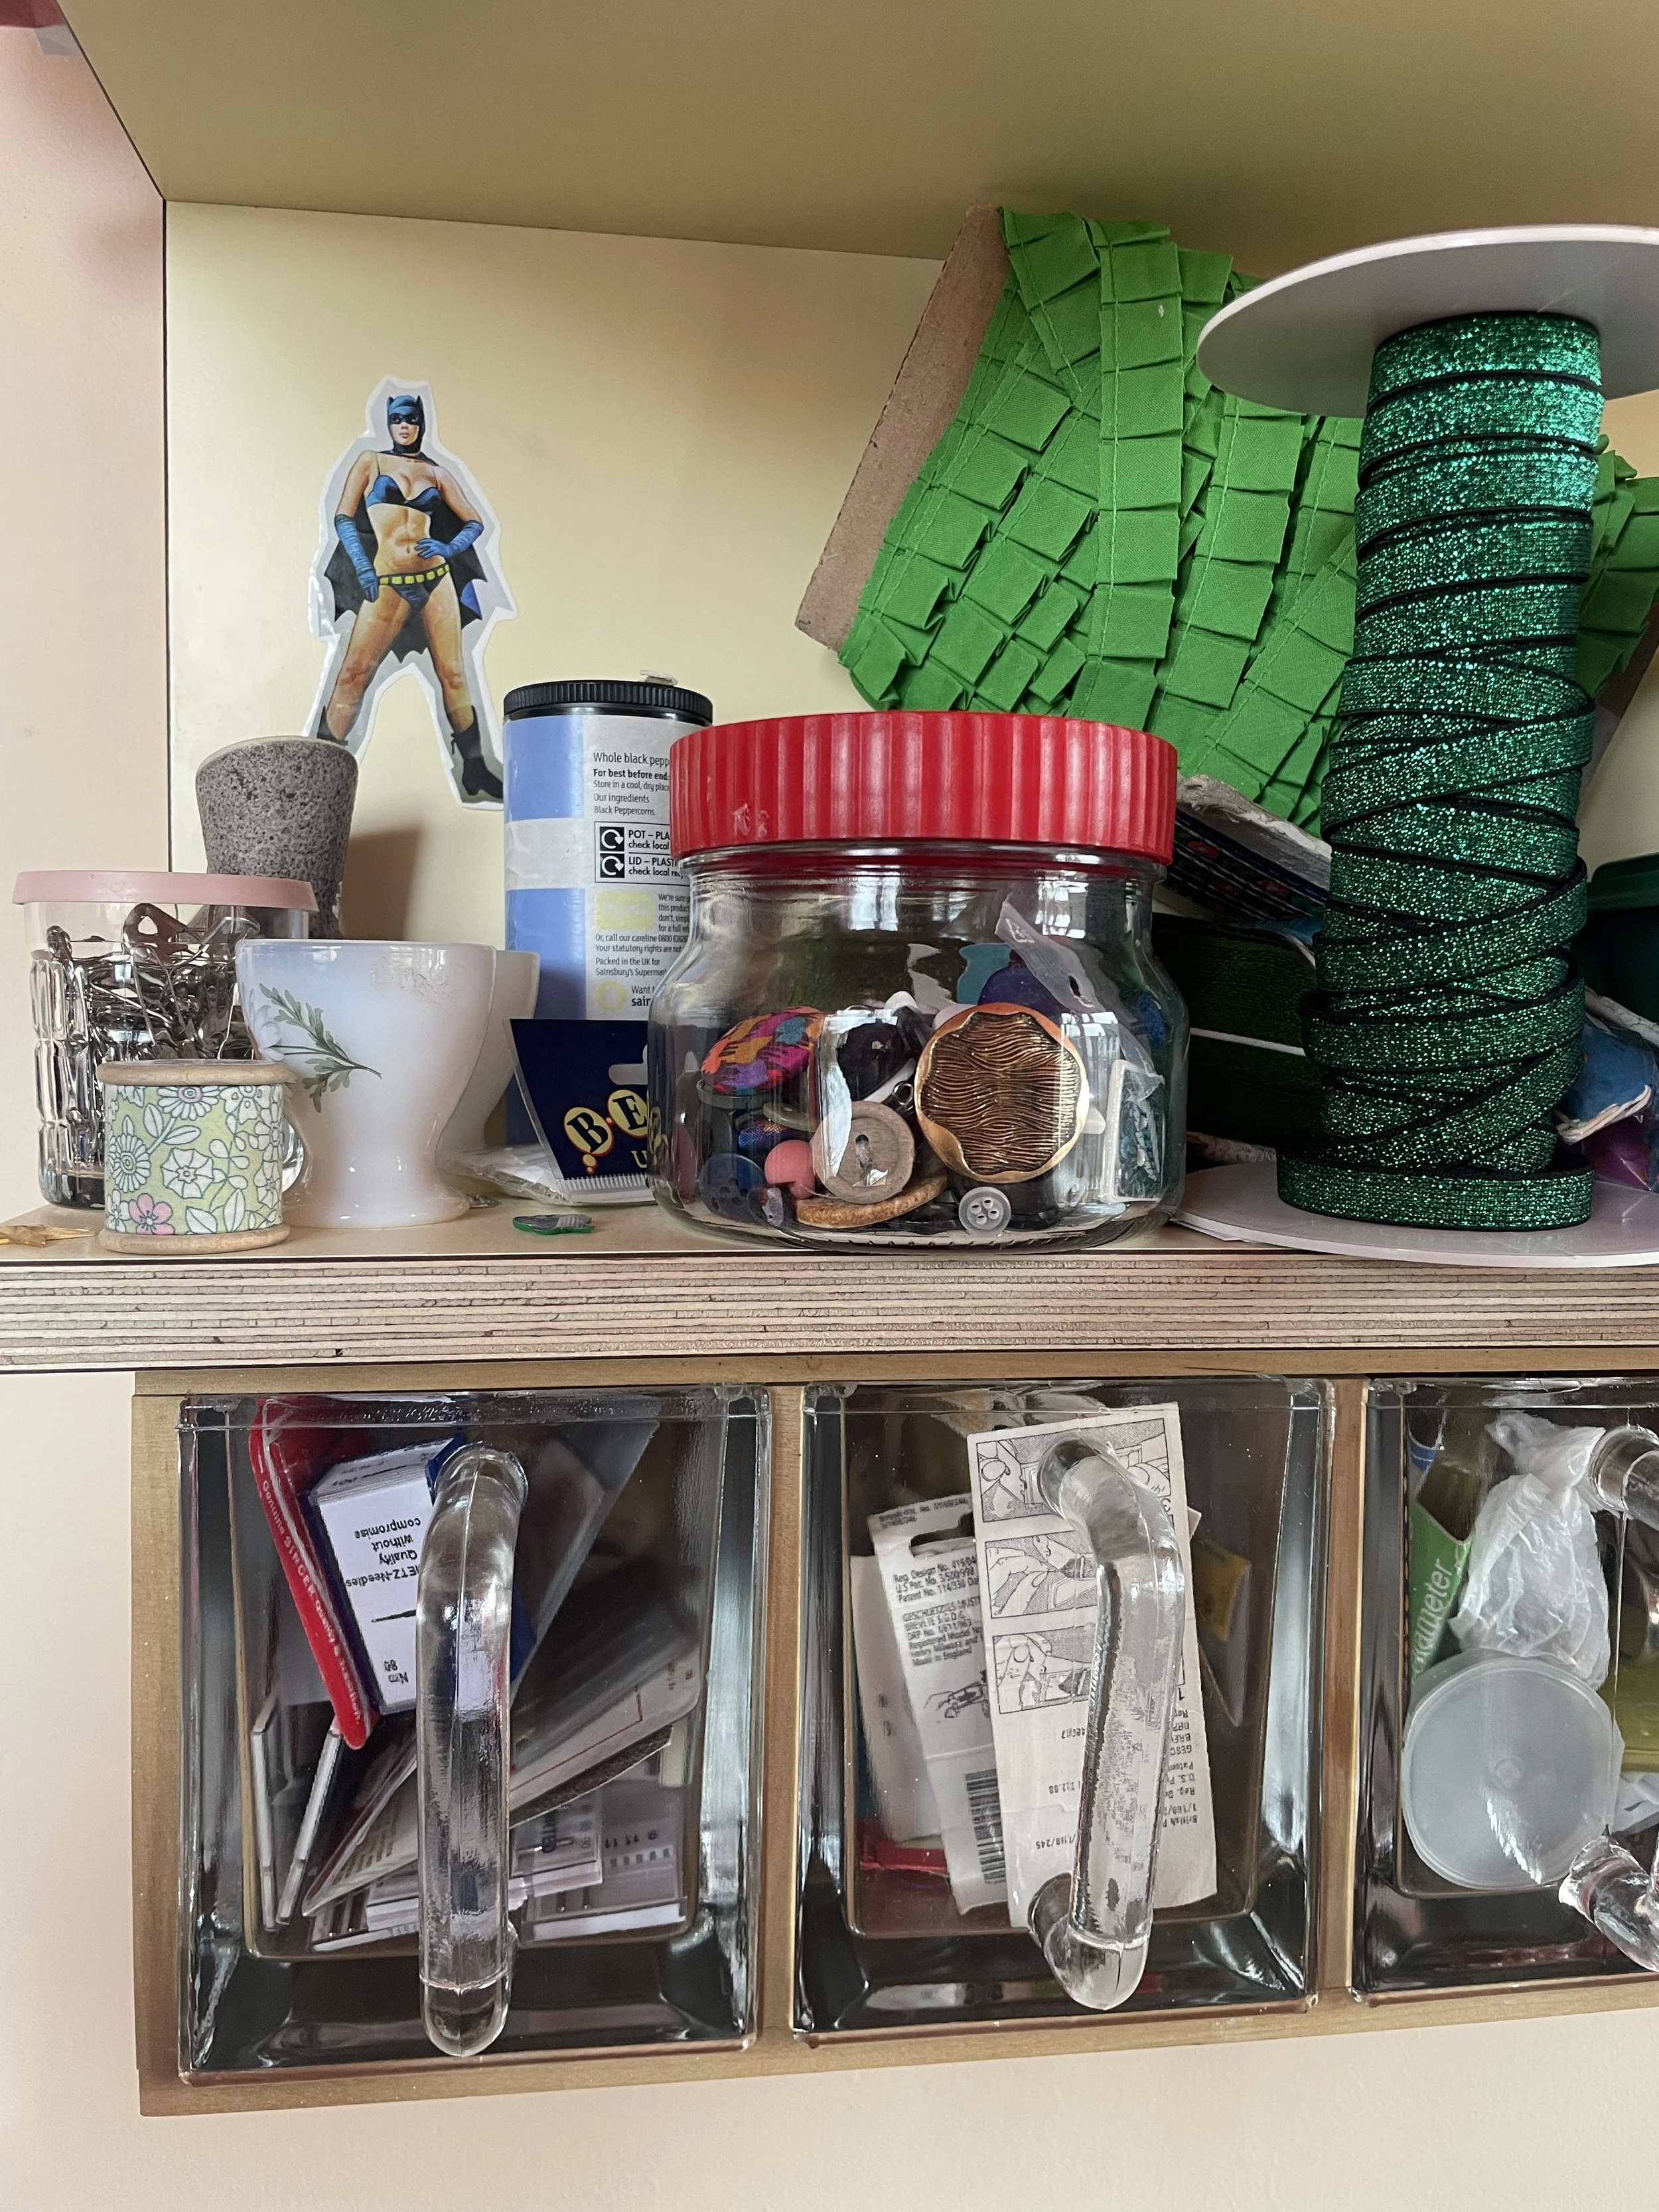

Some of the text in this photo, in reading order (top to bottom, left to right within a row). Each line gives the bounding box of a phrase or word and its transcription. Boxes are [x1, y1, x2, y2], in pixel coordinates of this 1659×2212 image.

[593, 751, 622, 763] Whole
[624, 752, 648, 764] black
[593, 769, 606, 777] For
[609, 769, 626, 778] best
[628, 769, 653, 779] before
[613, 780, 620, 788] in
[626, 780, 642, 790] cool,
[644, 781, 654, 792] dry
[594, 793, 650, 804] Our ingredients
[594, 806, 613, 814] Black
[628, 830, 646, 839] POT
[628, 839, 670, 850] check local
[629, 856, 642, 865] LID
[628, 866, 651, 875] check
[653, 867, 670, 876] local
[672, 924, 681, 932] full
[595, 934, 605, 942] Or,
[606, 933, 618, 942] call
[632, 934, 658, 942] careline
[612, 944, 643, 954] statutory
[644, 944, 662, 955] rights
[596, 968, 633, 977] Sainsbury's
[632, 986, 650, 994] Want
[354, 1517, 421, 1540] compromise
[263, 1480, 285, 1534] Genuine
[284, 1535, 316, 1599] SINGER
[372, 1534, 414, 1552] without
[378, 1549, 417, 1566] Quality
[1178, 1687, 1186, 1702] 1
[1170, 1744, 1192, 1755] GESC
[1177, 1787, 1195, 1796] Reg.
[1170, 1814, 1198, 1825] British
